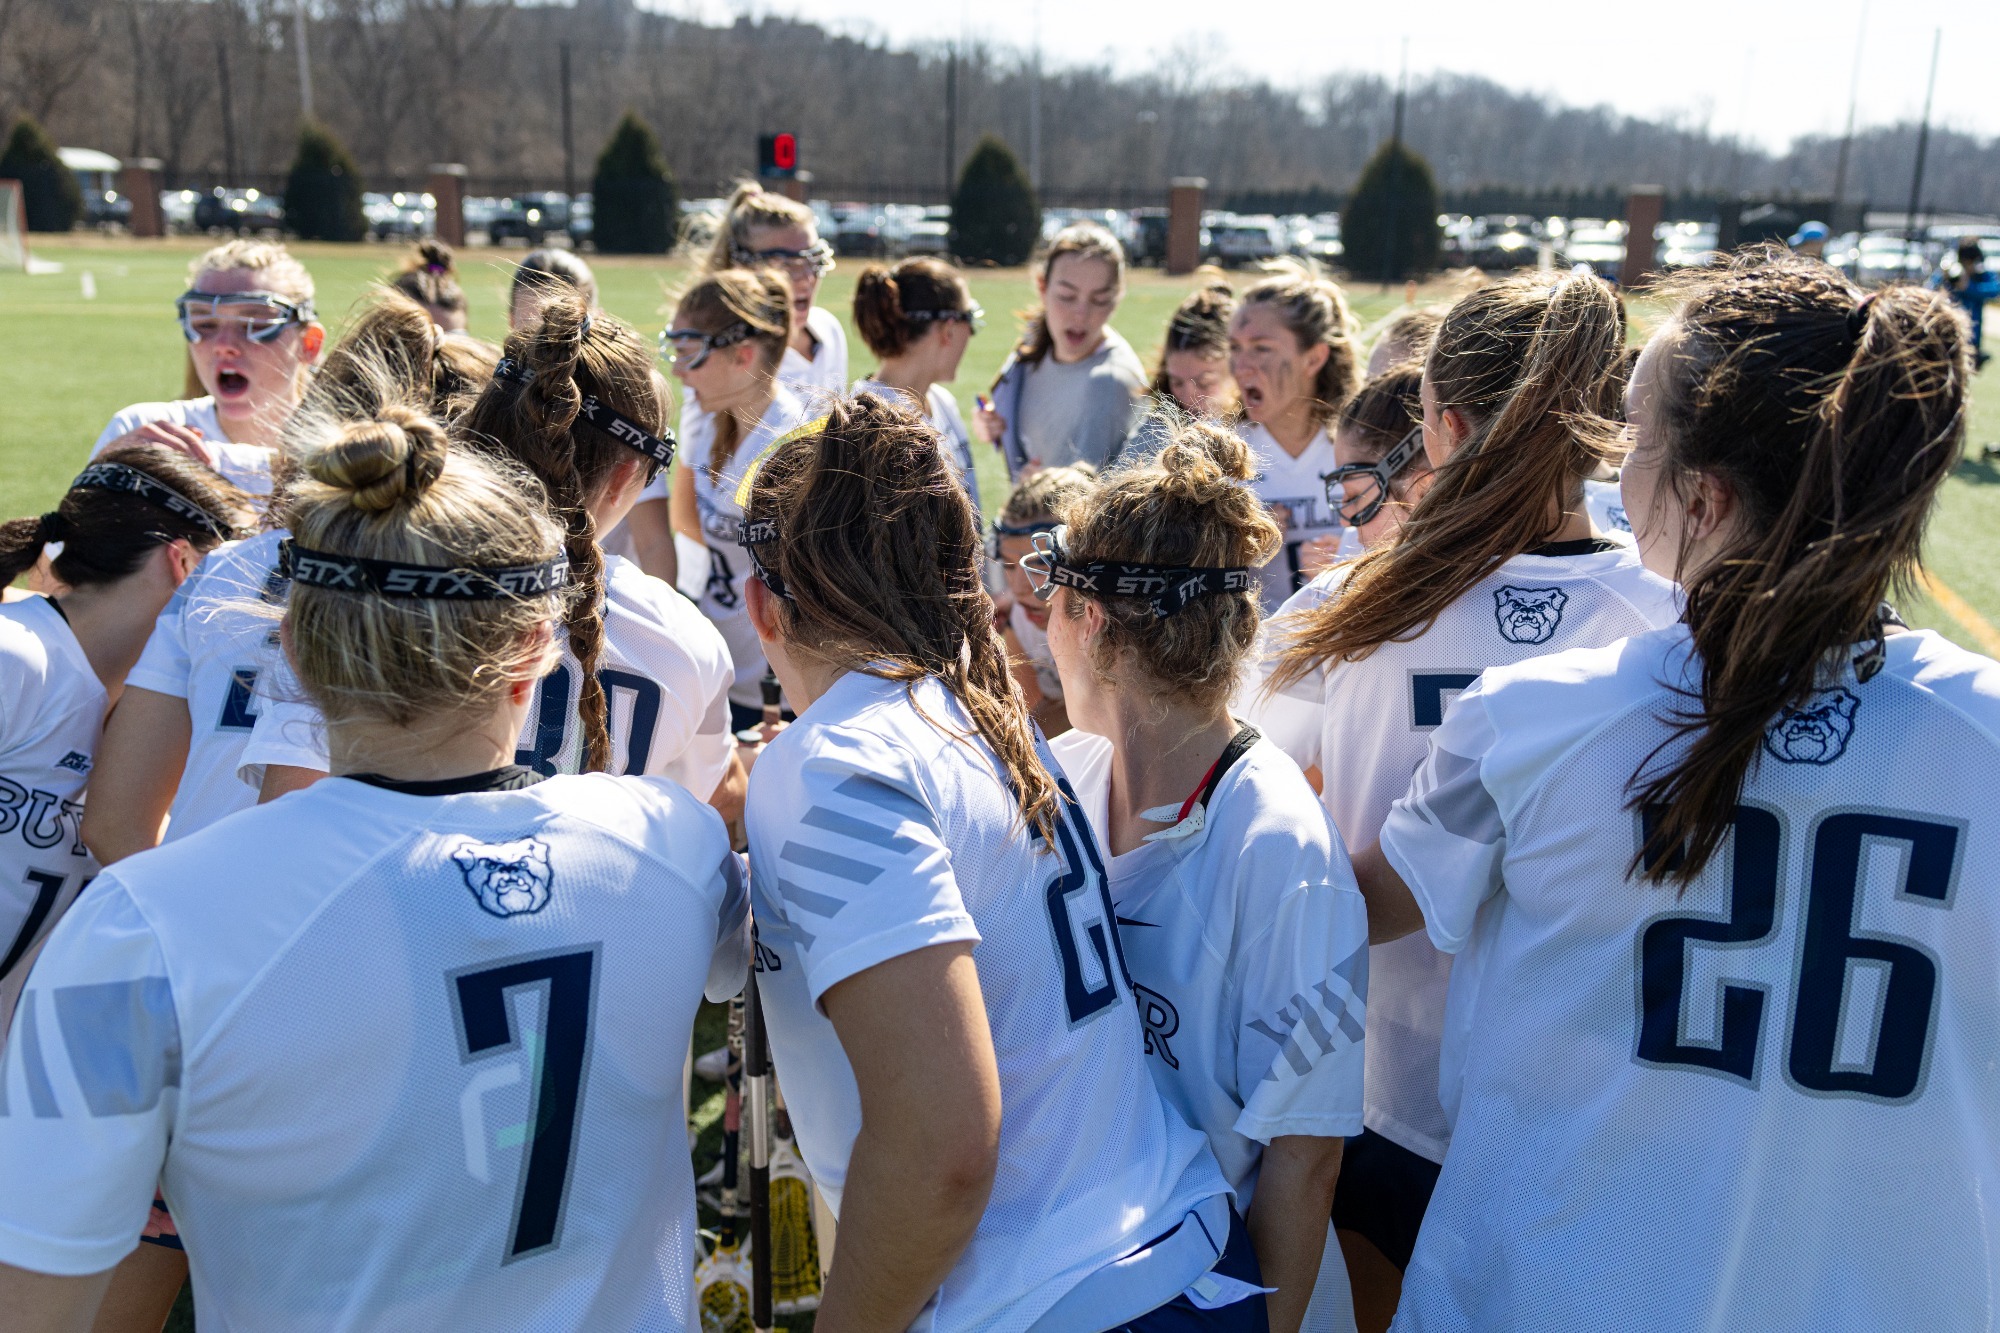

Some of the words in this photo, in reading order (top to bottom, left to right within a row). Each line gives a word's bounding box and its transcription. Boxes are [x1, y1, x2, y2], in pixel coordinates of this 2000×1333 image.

[607, 417, 650, 451] STX
[652, 444, 674, 464] ST
[1386, 426, 1423, 471] ST
[749, 521, 777, 542] STX
[295, 557, 358, 587] STX
[383, 568, 475, 596] STX
[496, 568, 545, 596] STX
[550, 562, 569, 586] ST
[1053, 565, 1100, 591] STX
[1223, 570, 1249, 589] ST
[1631, 798, 1970, 1107] 26
[443, 941, 603, 1268] 7
